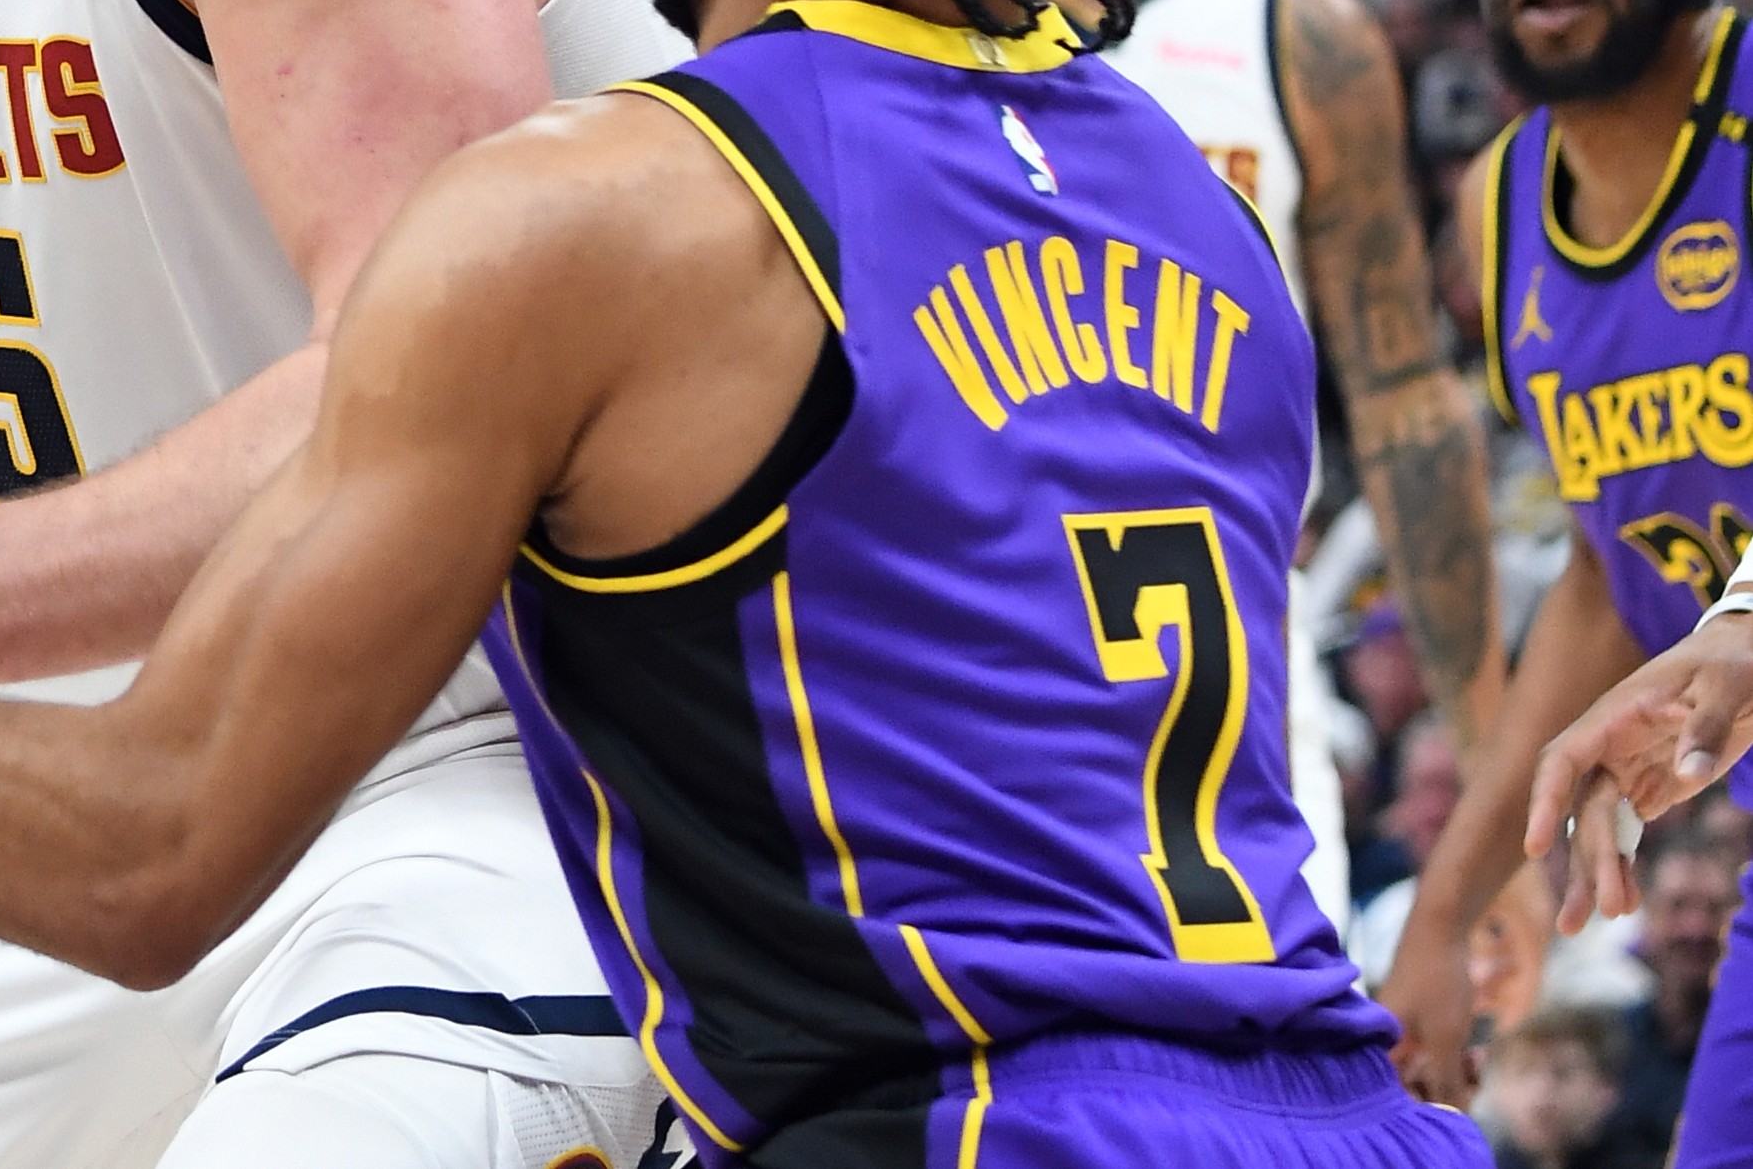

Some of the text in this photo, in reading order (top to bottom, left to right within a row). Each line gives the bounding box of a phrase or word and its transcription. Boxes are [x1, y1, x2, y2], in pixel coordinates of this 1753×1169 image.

[913, 236, 1250, 434] VINCENT
[1527, 351, 1753, 502] LAKERS
[1061, 506, 1277, 964] 7
